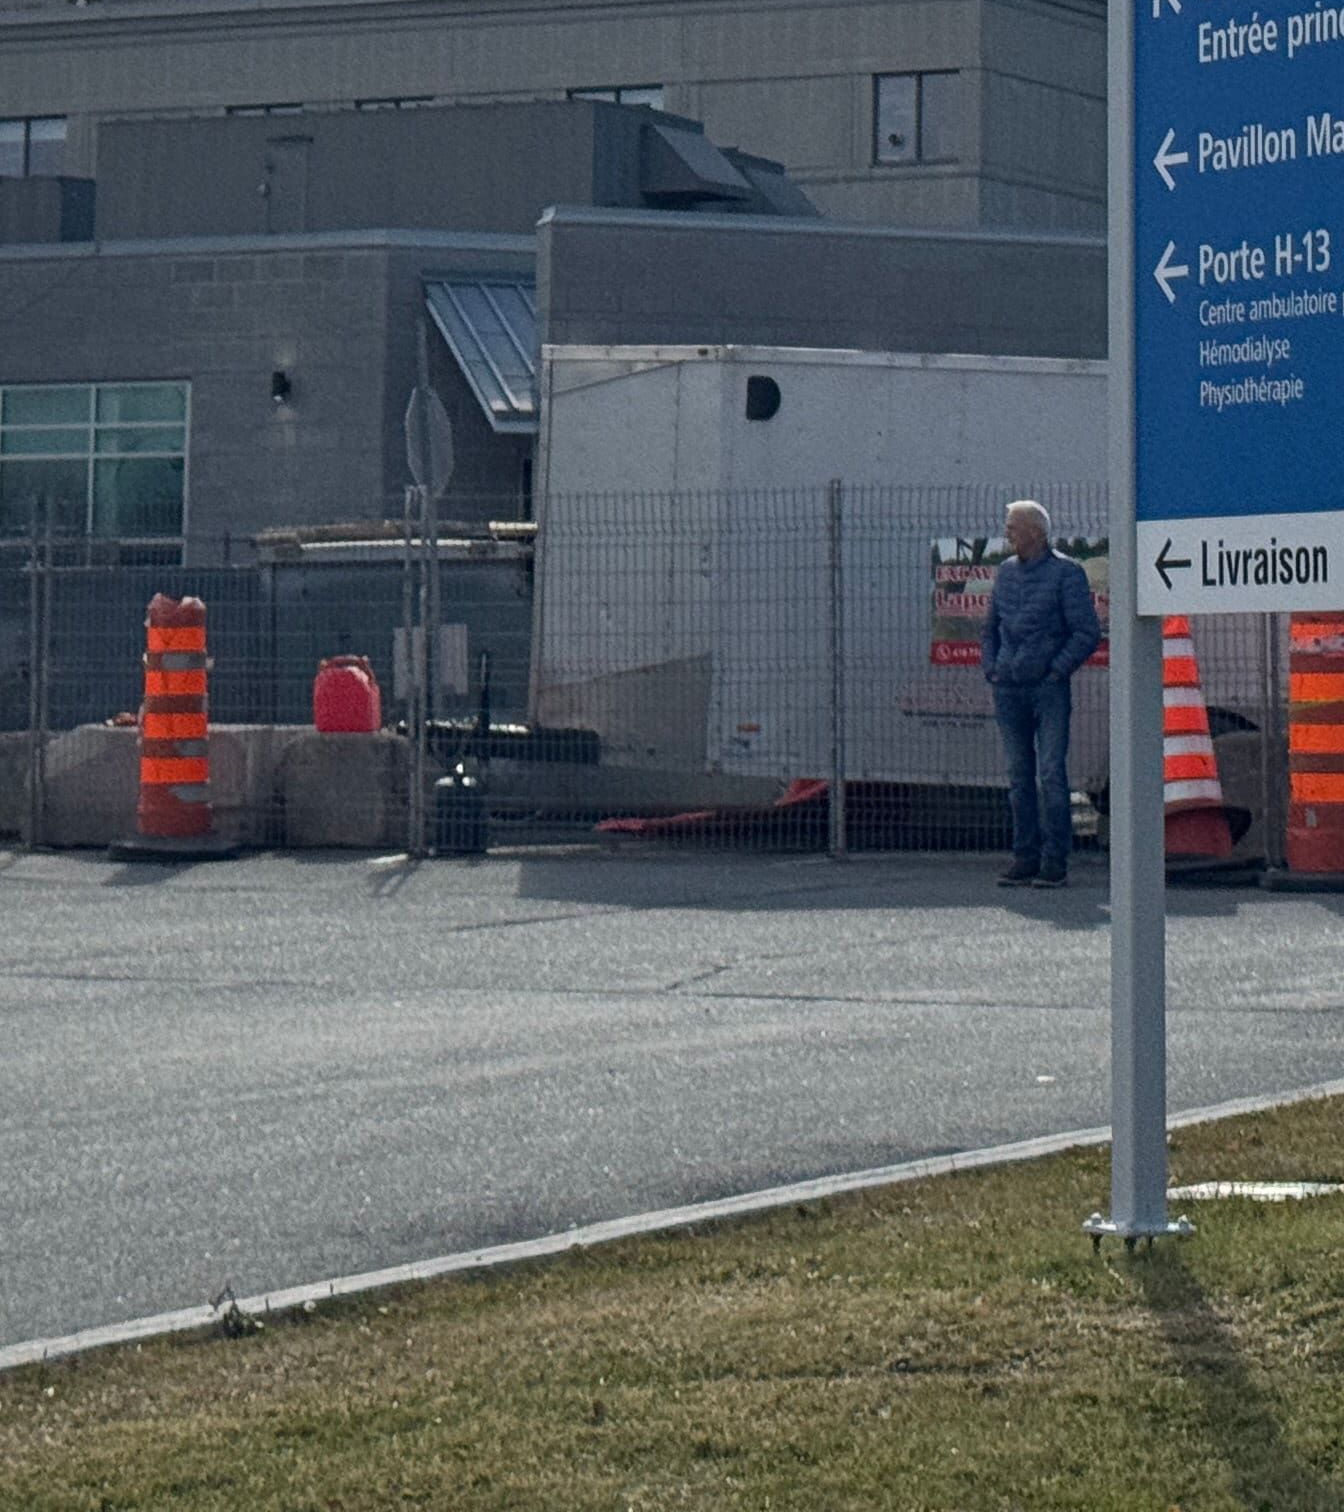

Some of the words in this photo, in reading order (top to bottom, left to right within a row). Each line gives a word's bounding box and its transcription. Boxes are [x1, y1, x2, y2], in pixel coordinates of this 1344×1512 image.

[1199, 12, 1277, 62] Entrée
[1199, 124, 1295, 172] Pavillon
[1200, 241, 1265, 285] Porte
[1276, 229, 1330, 276] H-13
[1200, 299, 1245, 326] Centre
[1249, 288, 1337, 321] ambulatoire
[1200, 335, 1290, 367] Hémodialyse
[1200, 373, 1303, 412] Physiothérapie
[1202, 538, 1327, 586] Livraison
